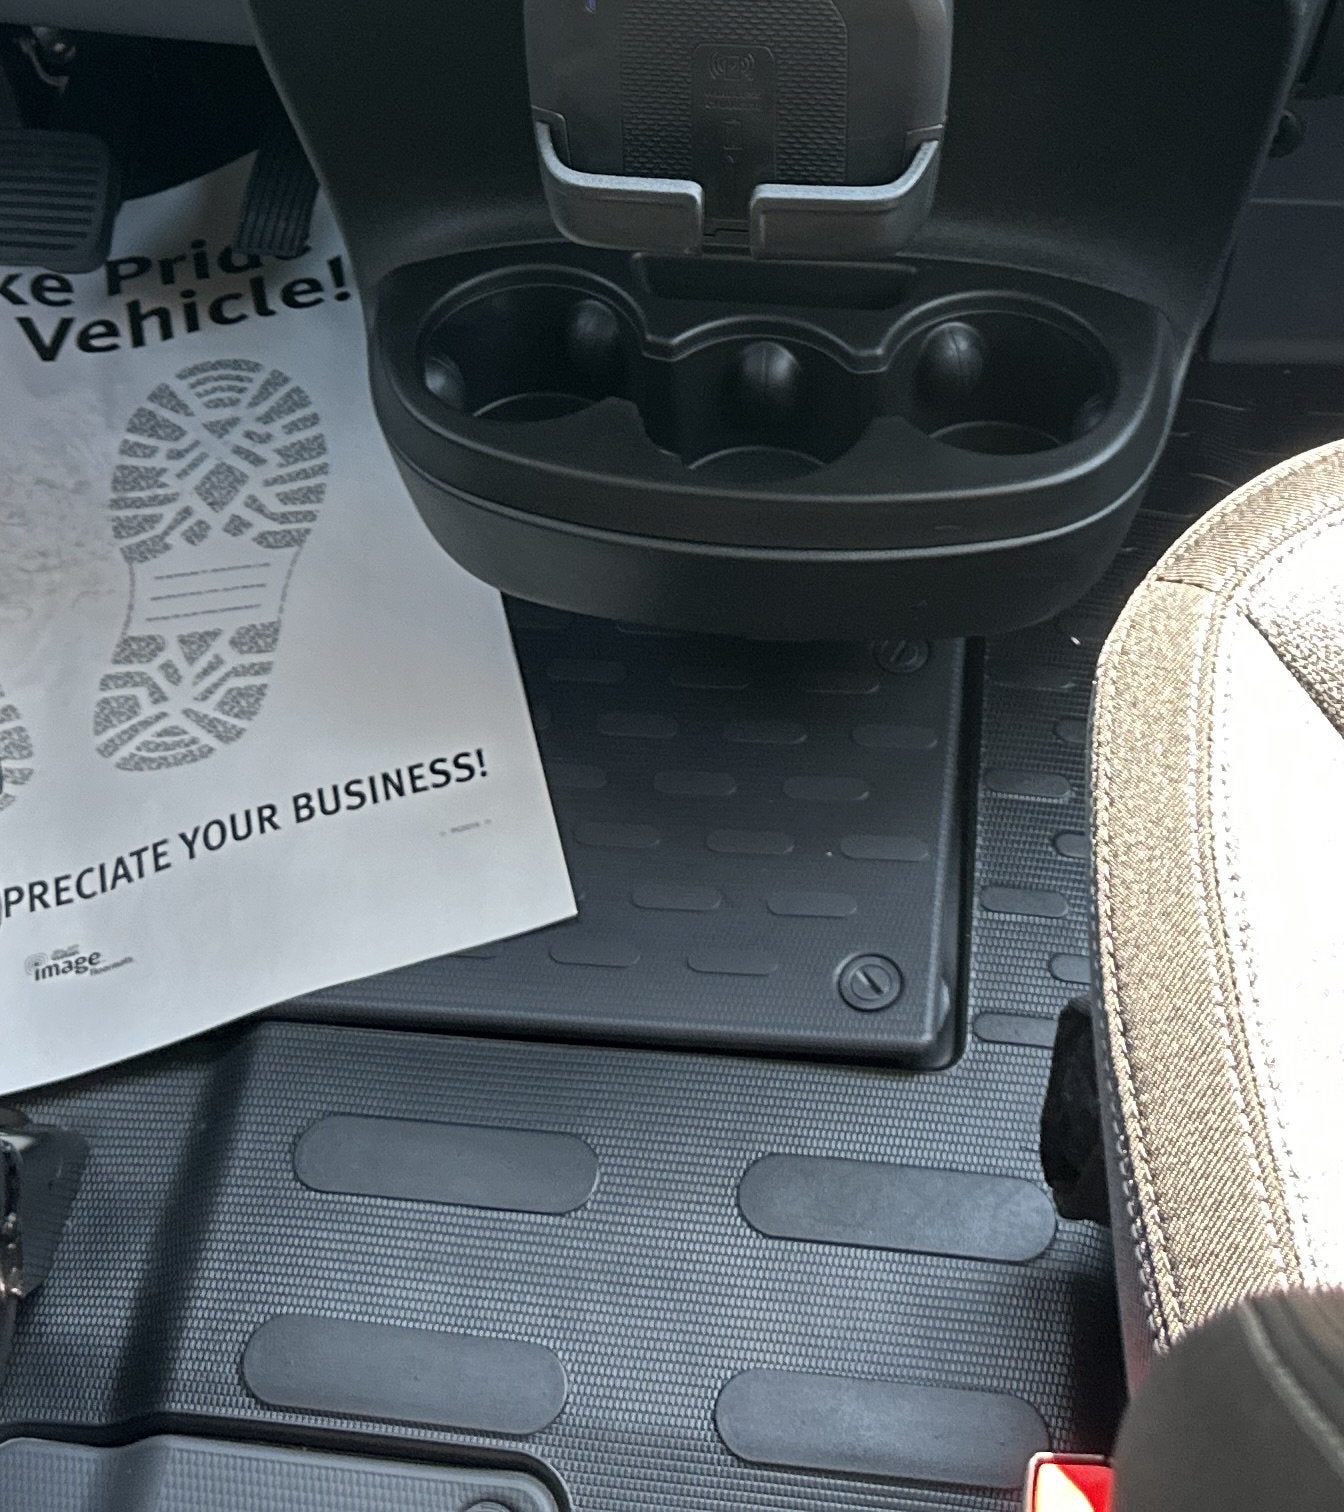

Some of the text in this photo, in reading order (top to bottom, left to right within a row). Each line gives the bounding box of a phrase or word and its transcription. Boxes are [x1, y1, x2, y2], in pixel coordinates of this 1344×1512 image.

[16, 256, 353, 362] Vehicle!
[3, 748, 488, 918] PRECIATE YOUR BUSINESS!
[35, 952, 101, 981] image
